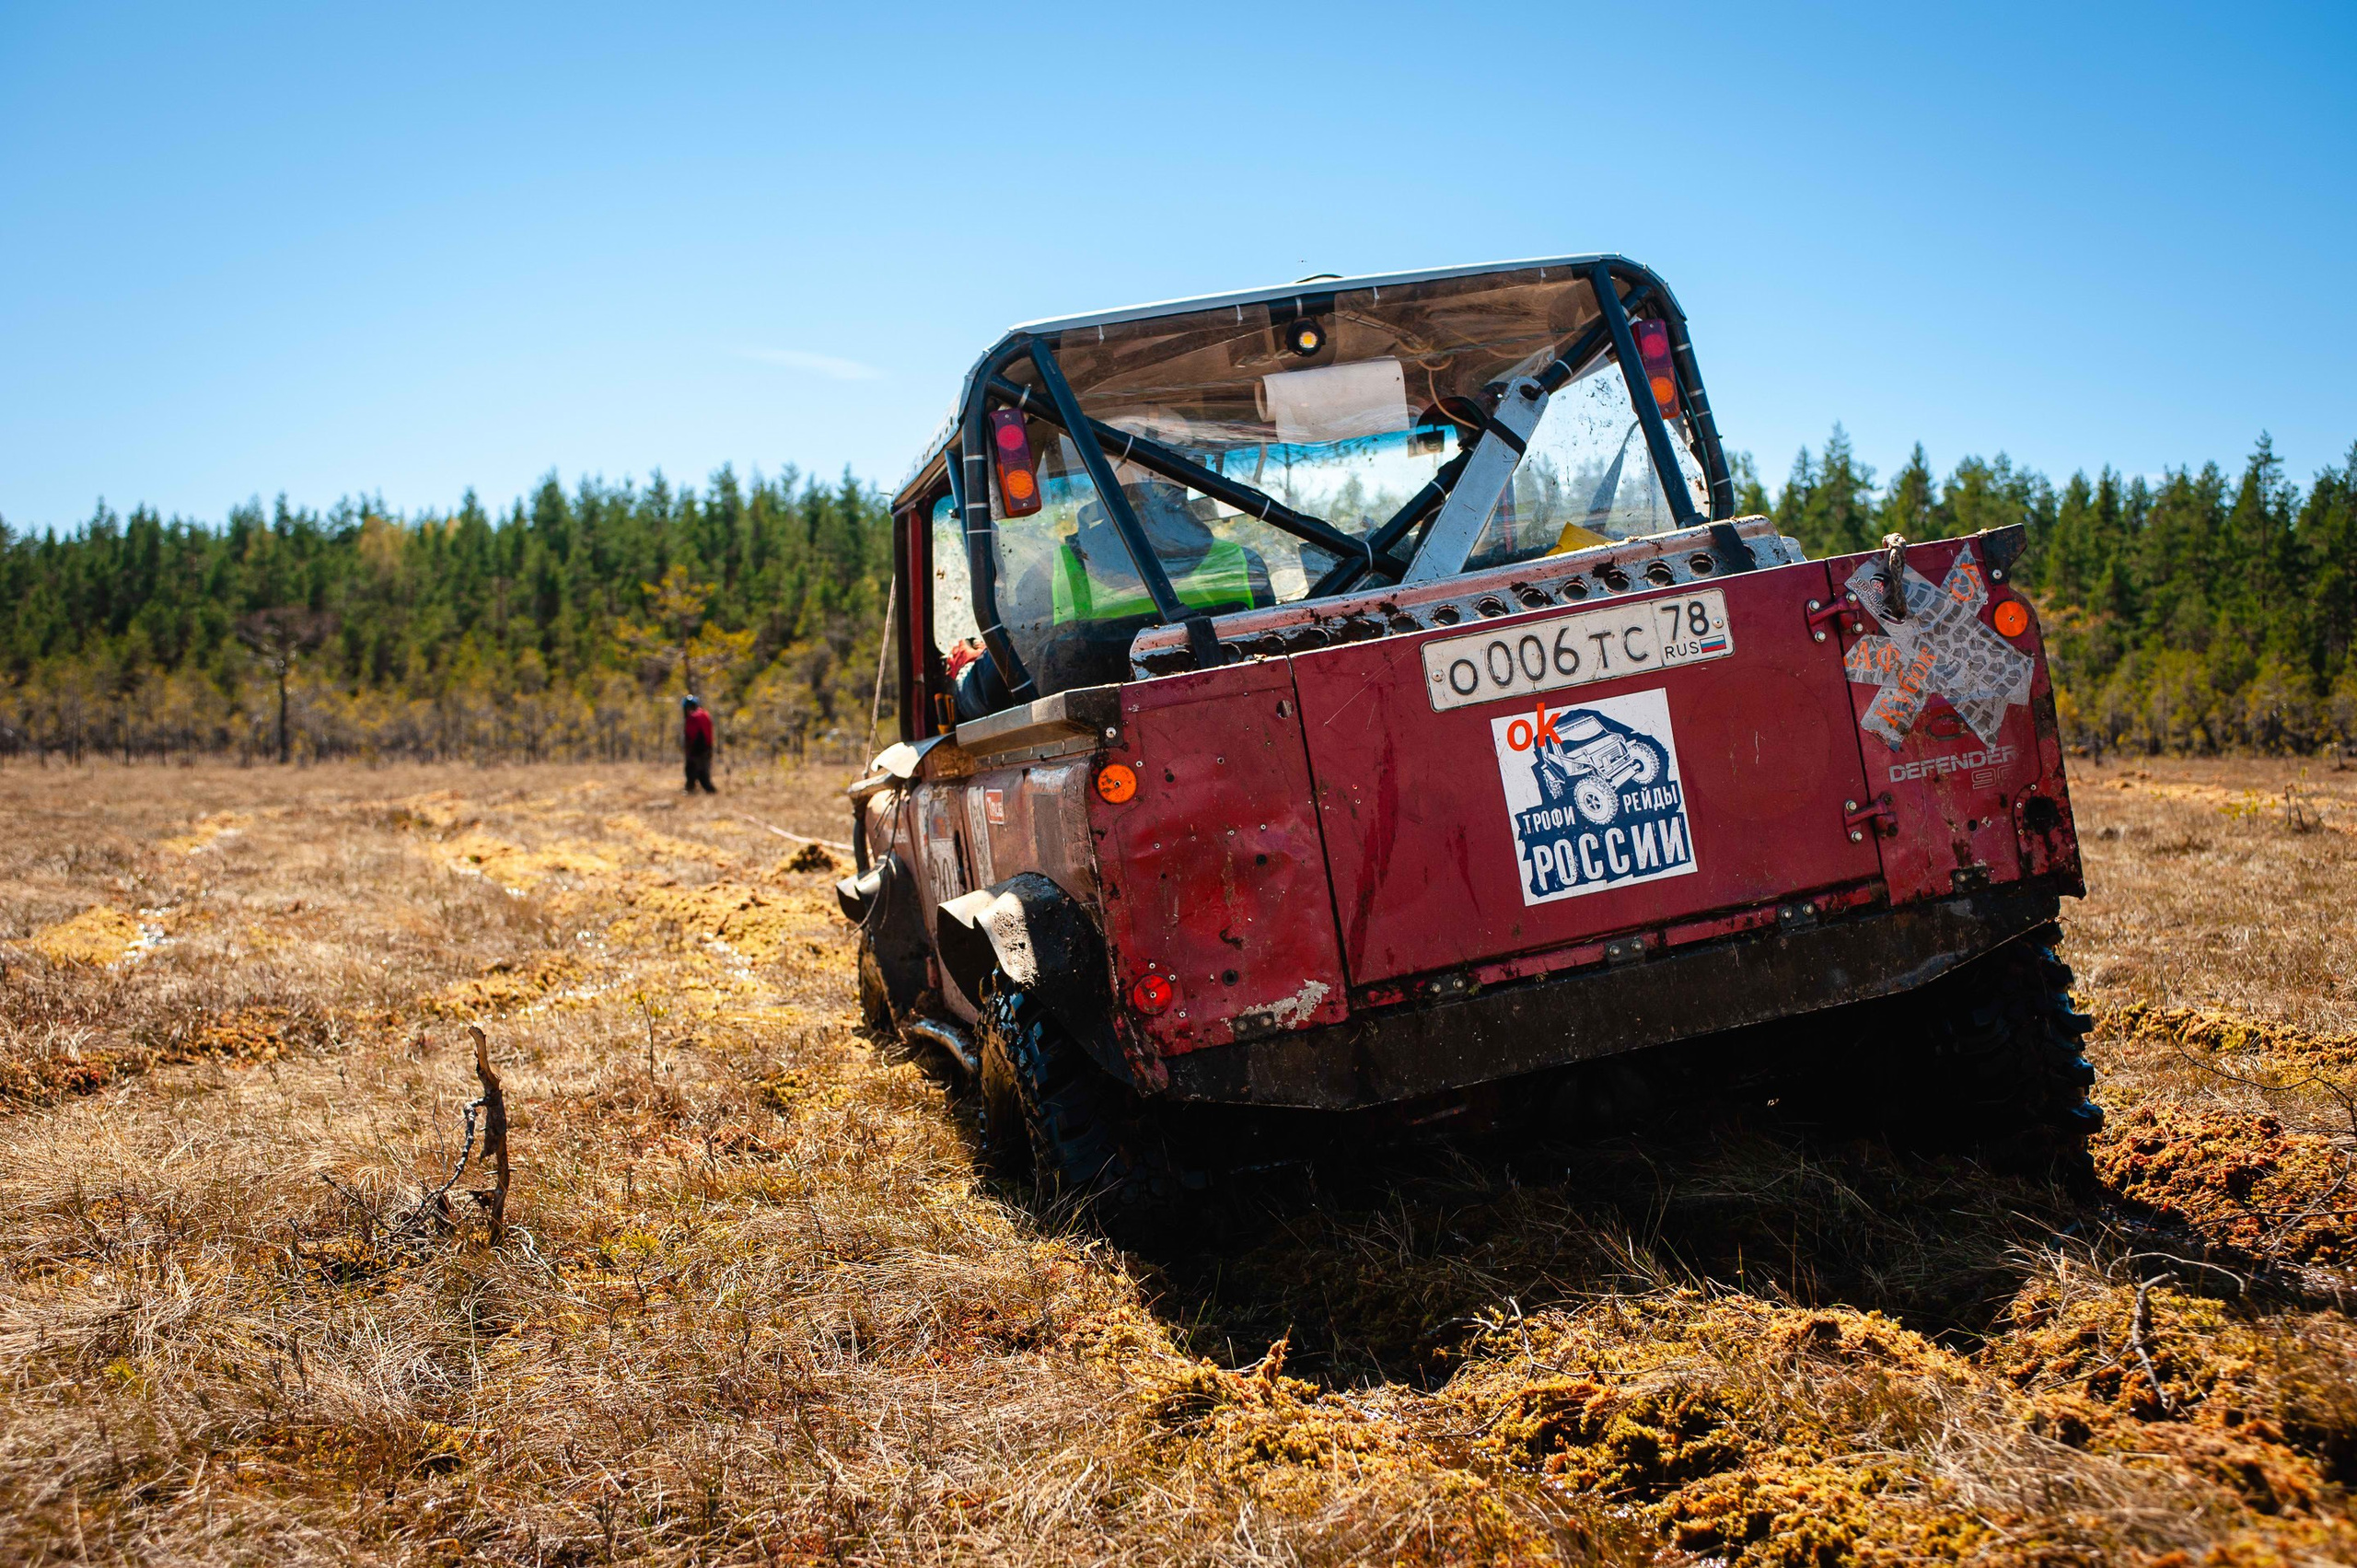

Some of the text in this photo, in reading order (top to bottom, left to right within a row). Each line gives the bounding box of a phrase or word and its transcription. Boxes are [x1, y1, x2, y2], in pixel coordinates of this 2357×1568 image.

[1853, 576, 1886, 610] АВТОСПОРТ
[1661, 601, 1710, 641] 78
[1665, 642, 1700, 659] RUS
[1843, 641, 1901, 673] АФ
[1506, 703, 1563, 751] ok
[1888, 745, 2016, 783] DEFENDER
[1523, 784, 1678, 835] ТРОФИ РЕЙДЫ
[1532, 816, 1687, 891] РОССИИ
